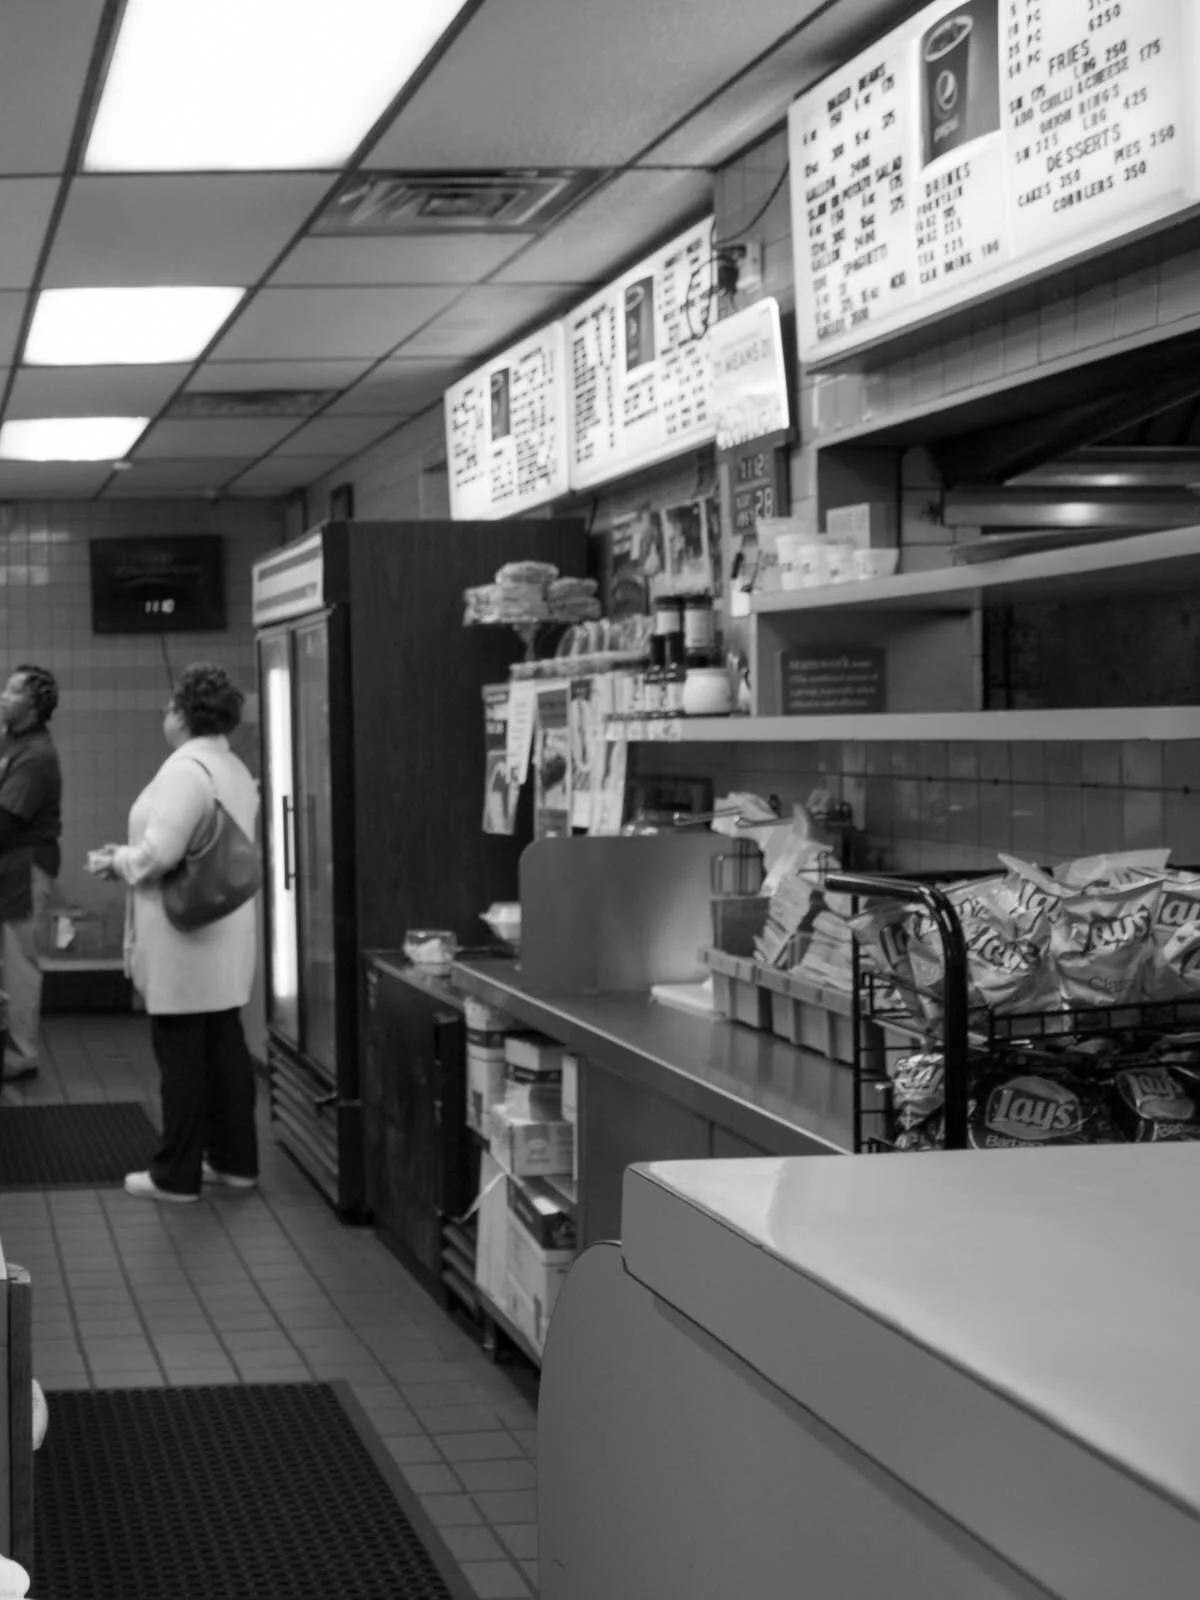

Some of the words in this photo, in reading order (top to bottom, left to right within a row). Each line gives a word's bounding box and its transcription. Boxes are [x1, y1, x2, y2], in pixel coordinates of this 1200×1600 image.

[1048, 38, 1090, 77] FRIES
[1139, 37, 1161, 63] 175
[1047, 123, 1120, 174] DESSERTS
[1018, 181, 1051, 208] CAKES
